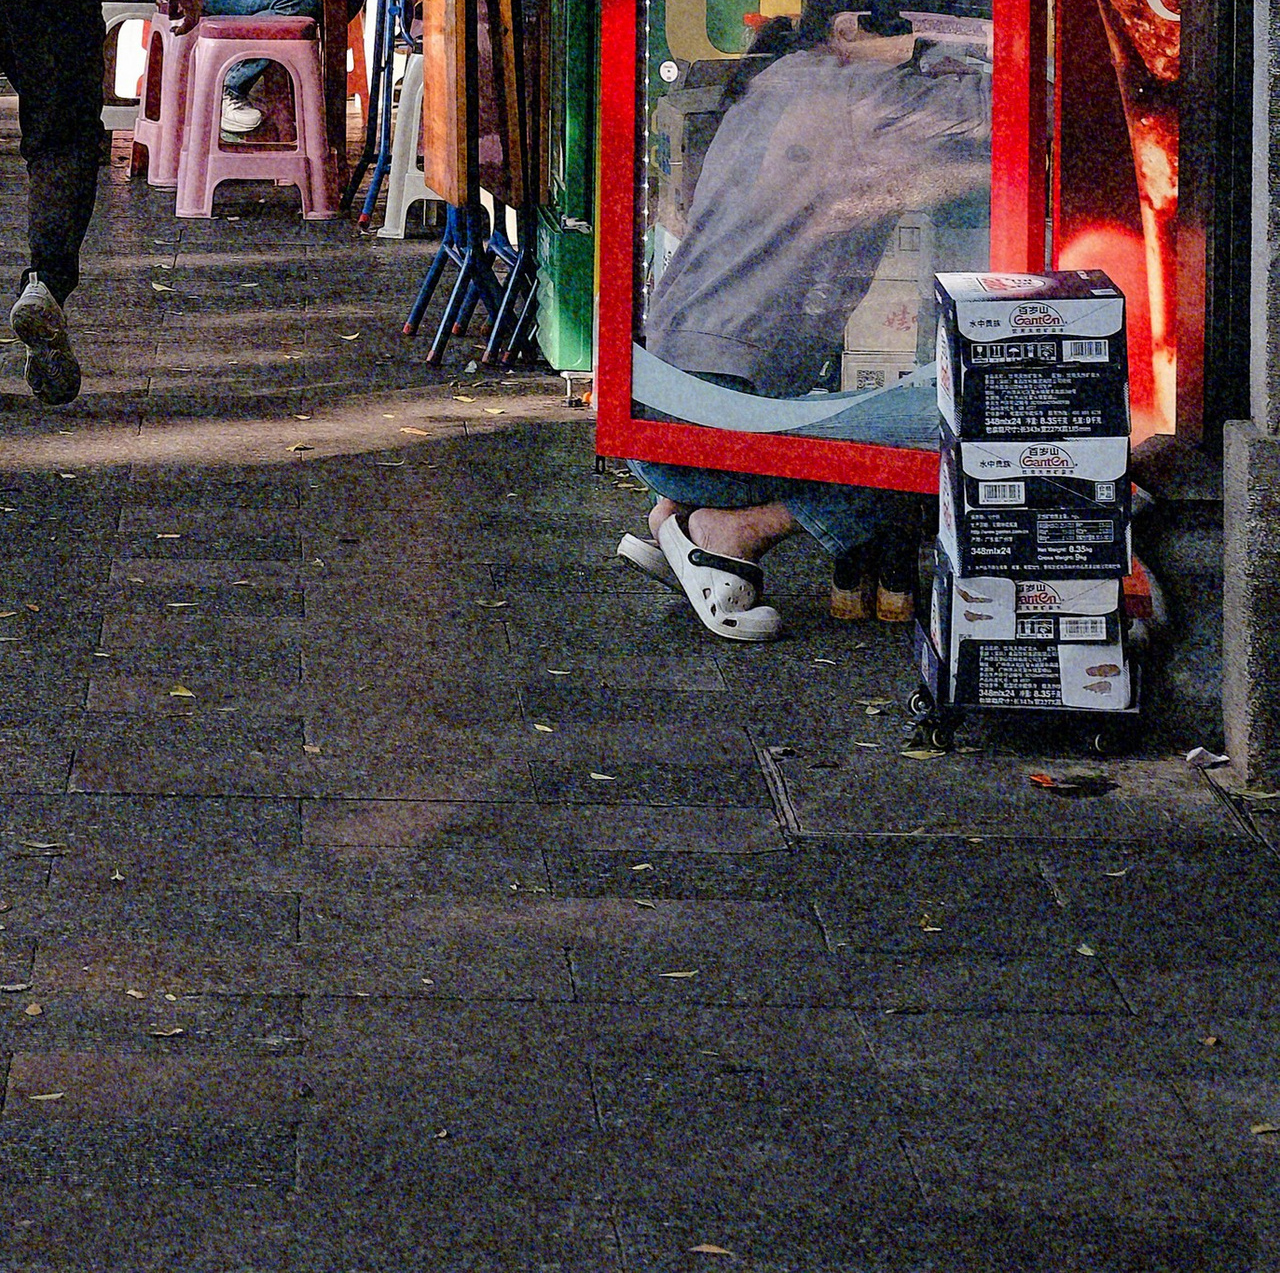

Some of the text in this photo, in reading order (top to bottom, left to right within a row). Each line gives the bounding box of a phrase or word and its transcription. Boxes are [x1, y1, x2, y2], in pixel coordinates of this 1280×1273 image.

[1018, 306, 1049, 315] 百岁山
[1028, 447, 1060, 456] 百岁山
